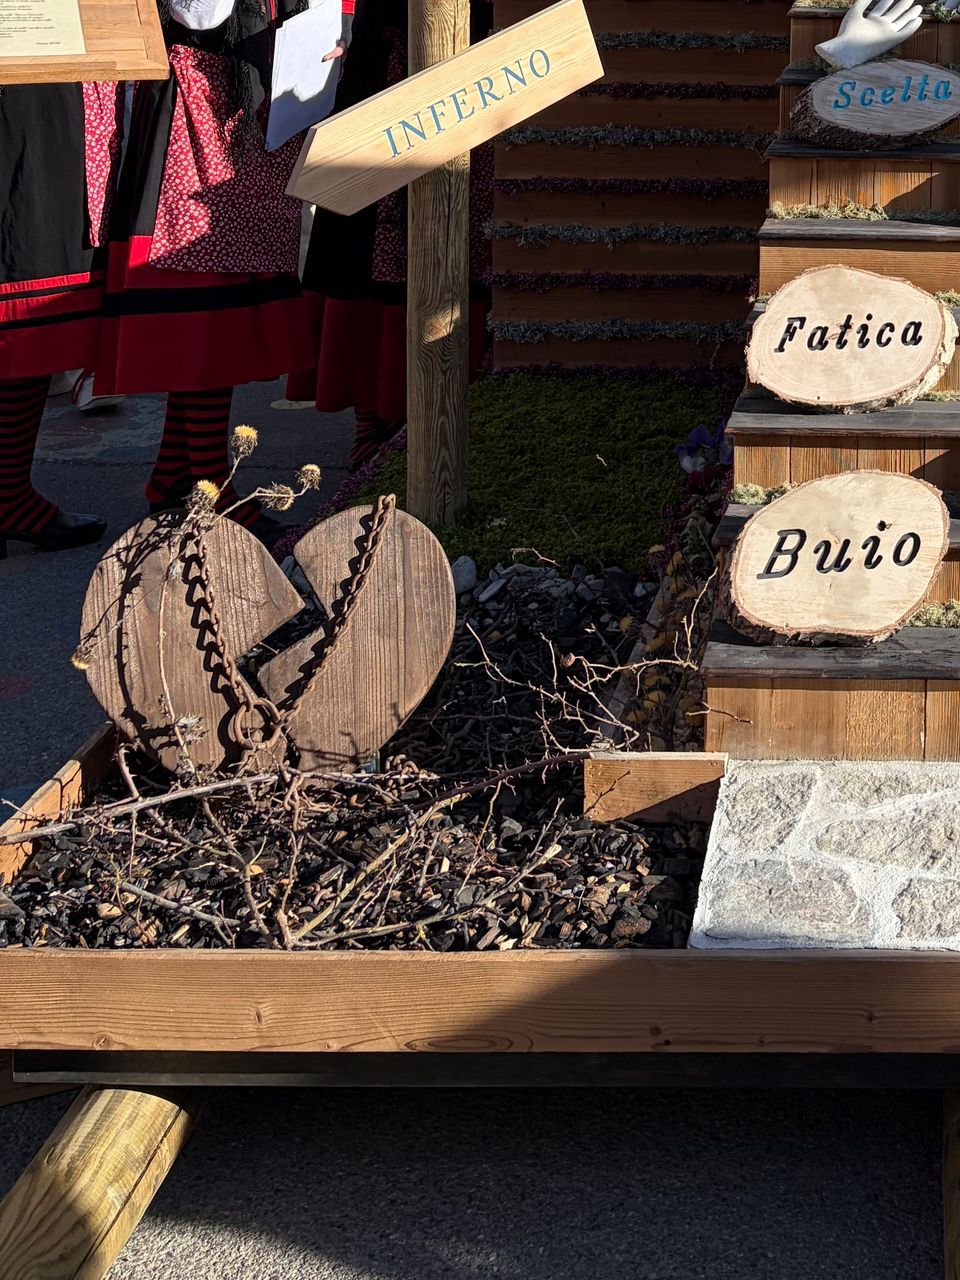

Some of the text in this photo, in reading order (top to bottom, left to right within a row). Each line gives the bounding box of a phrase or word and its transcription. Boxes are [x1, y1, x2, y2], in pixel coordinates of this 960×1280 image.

[382, 48, 552, 158] INFERNO
[832, 75, 953, 110] Scelta
[774, 313, 924, 353] Fatica
[756, 520, 921, 580] Buio
